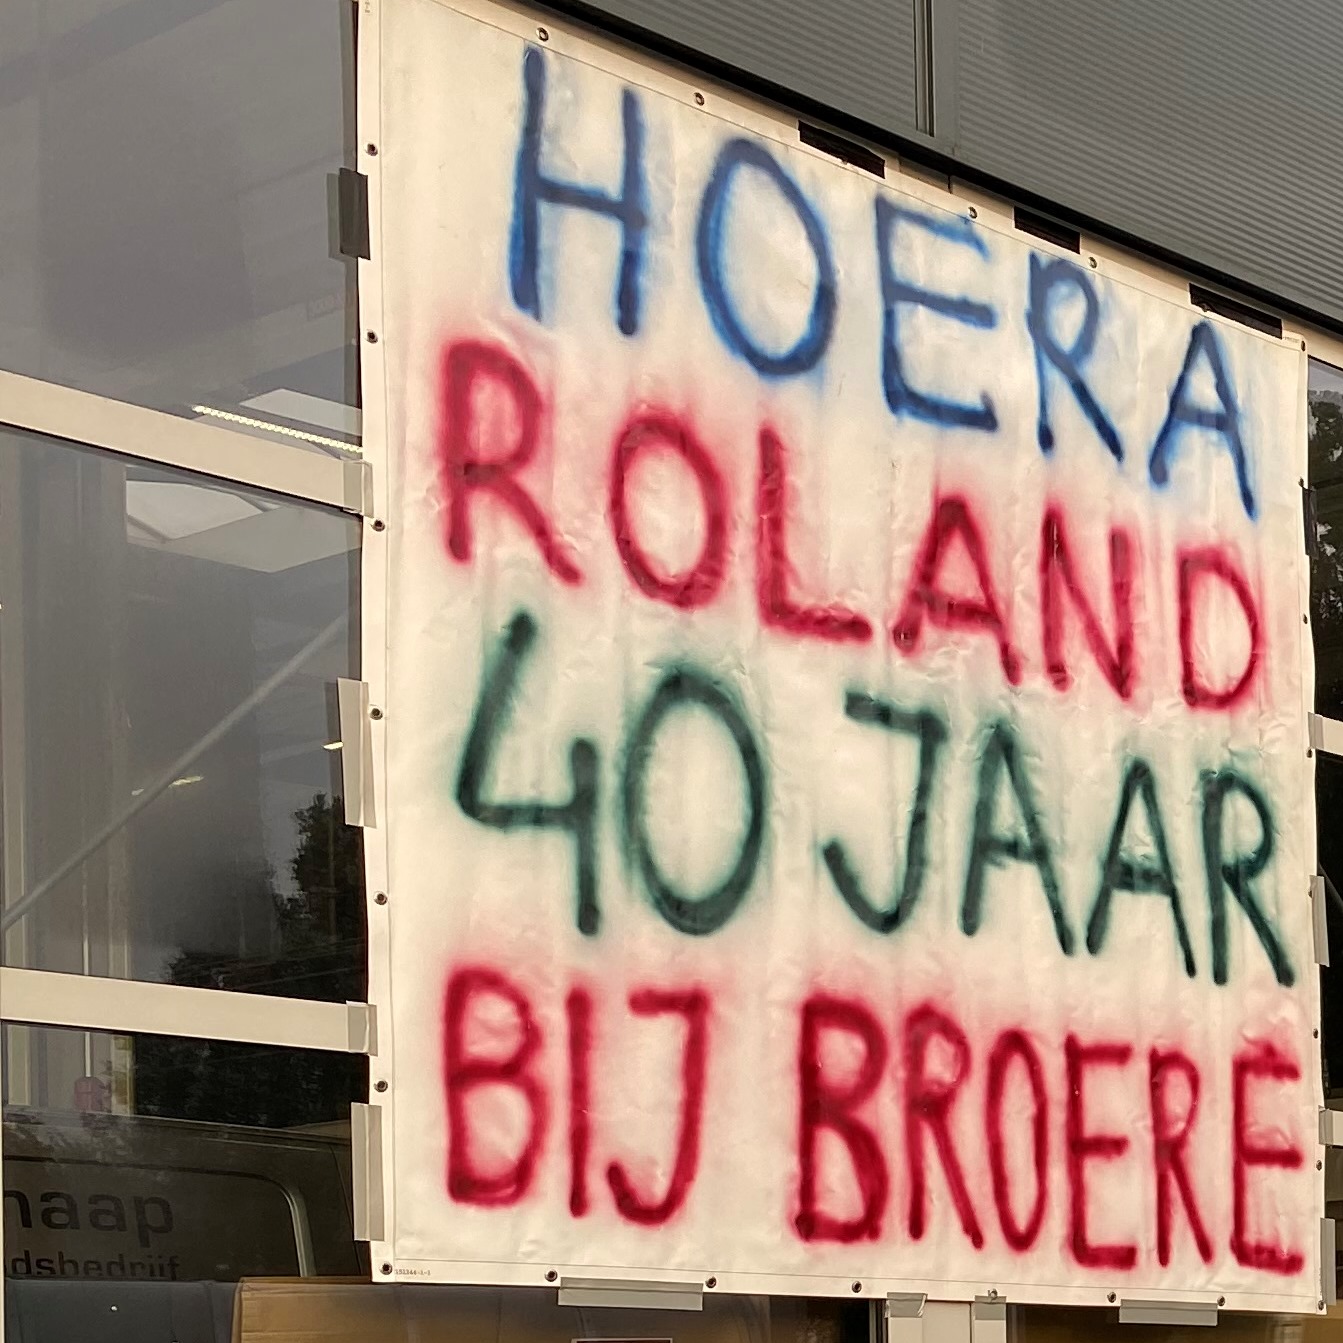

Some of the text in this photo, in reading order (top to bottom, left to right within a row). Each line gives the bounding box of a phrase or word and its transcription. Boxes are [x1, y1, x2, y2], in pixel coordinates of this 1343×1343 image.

[506, 44, 1263, 525] HOERA
[437, 337, 1269, 711] ROLAND
[454, 610, 1298, 987] 40 JAAR
[437, 965, 1307, 1277] BIJ BROERE
